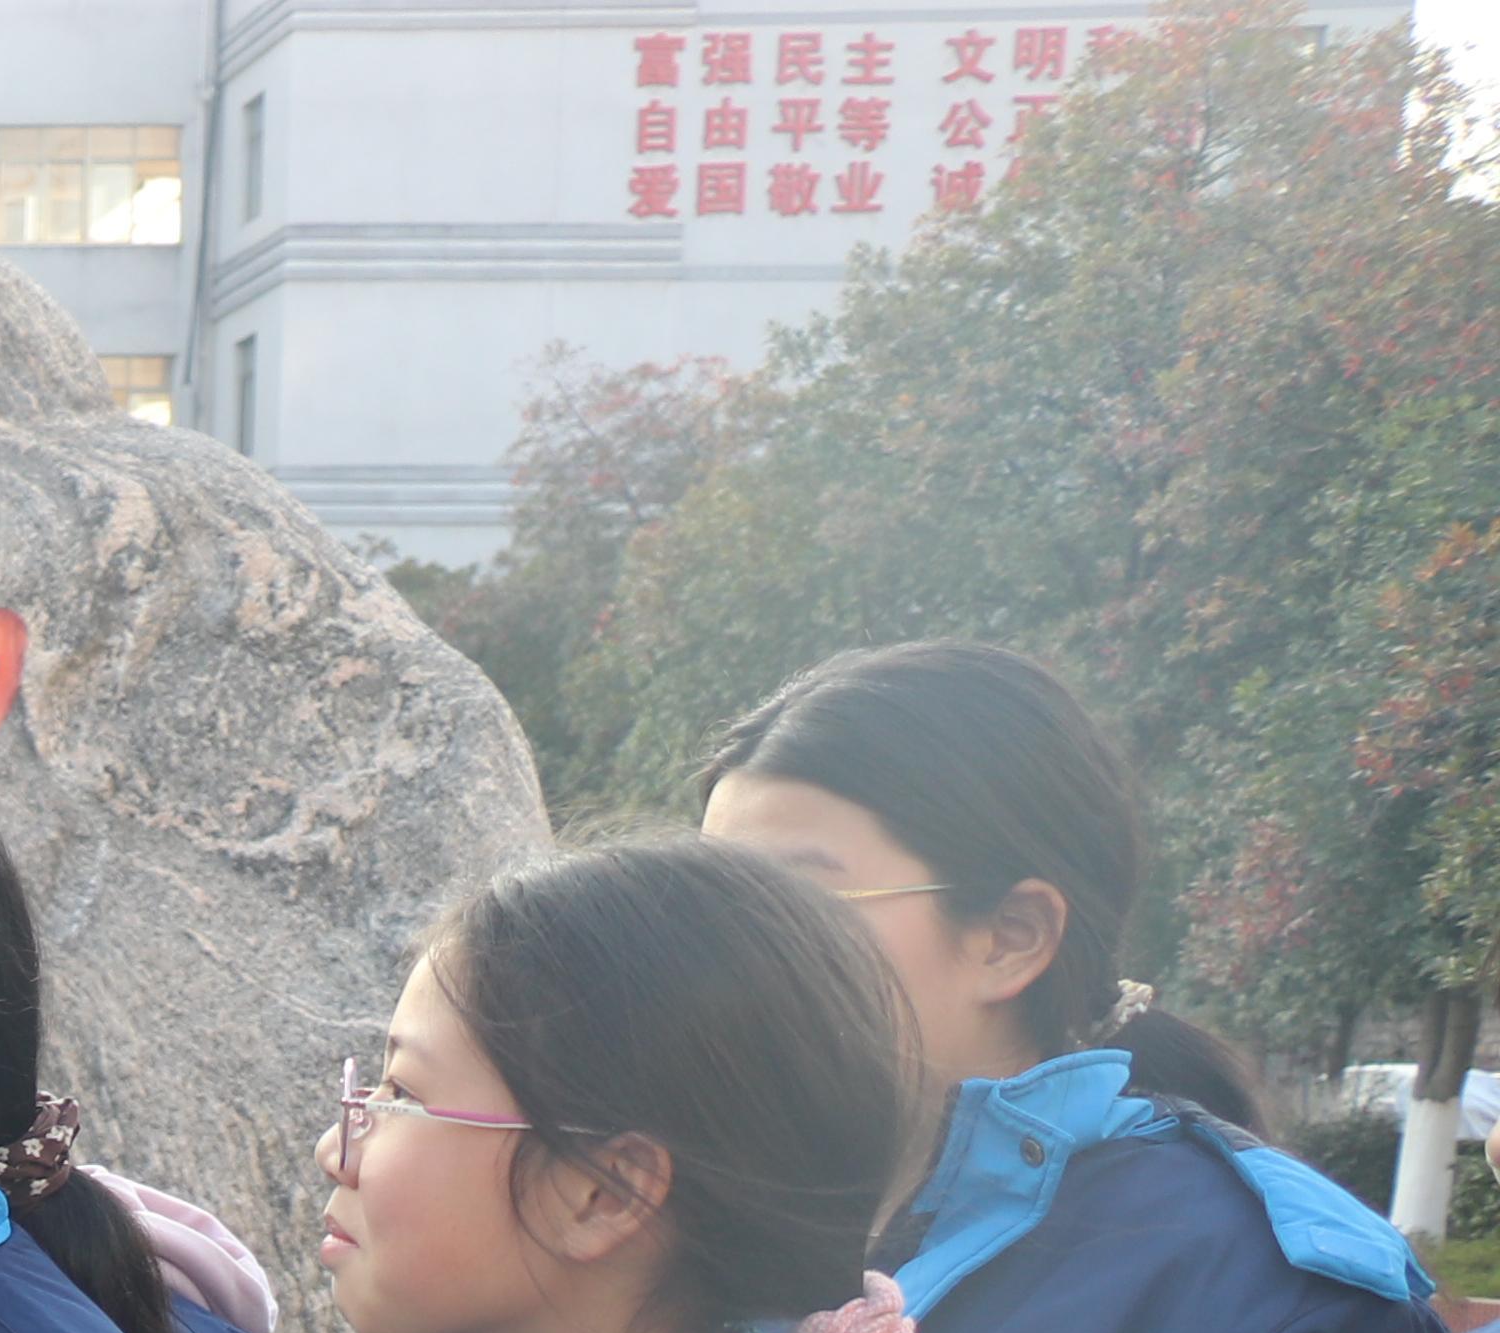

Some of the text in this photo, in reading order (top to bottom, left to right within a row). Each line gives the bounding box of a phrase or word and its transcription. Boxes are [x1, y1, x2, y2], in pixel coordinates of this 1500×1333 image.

[633, 32, 895, 87] 富强民主
[636, 96, 891, 153] 自由平等
[627, 158, 1024, 218] 爱国敬业 诚
